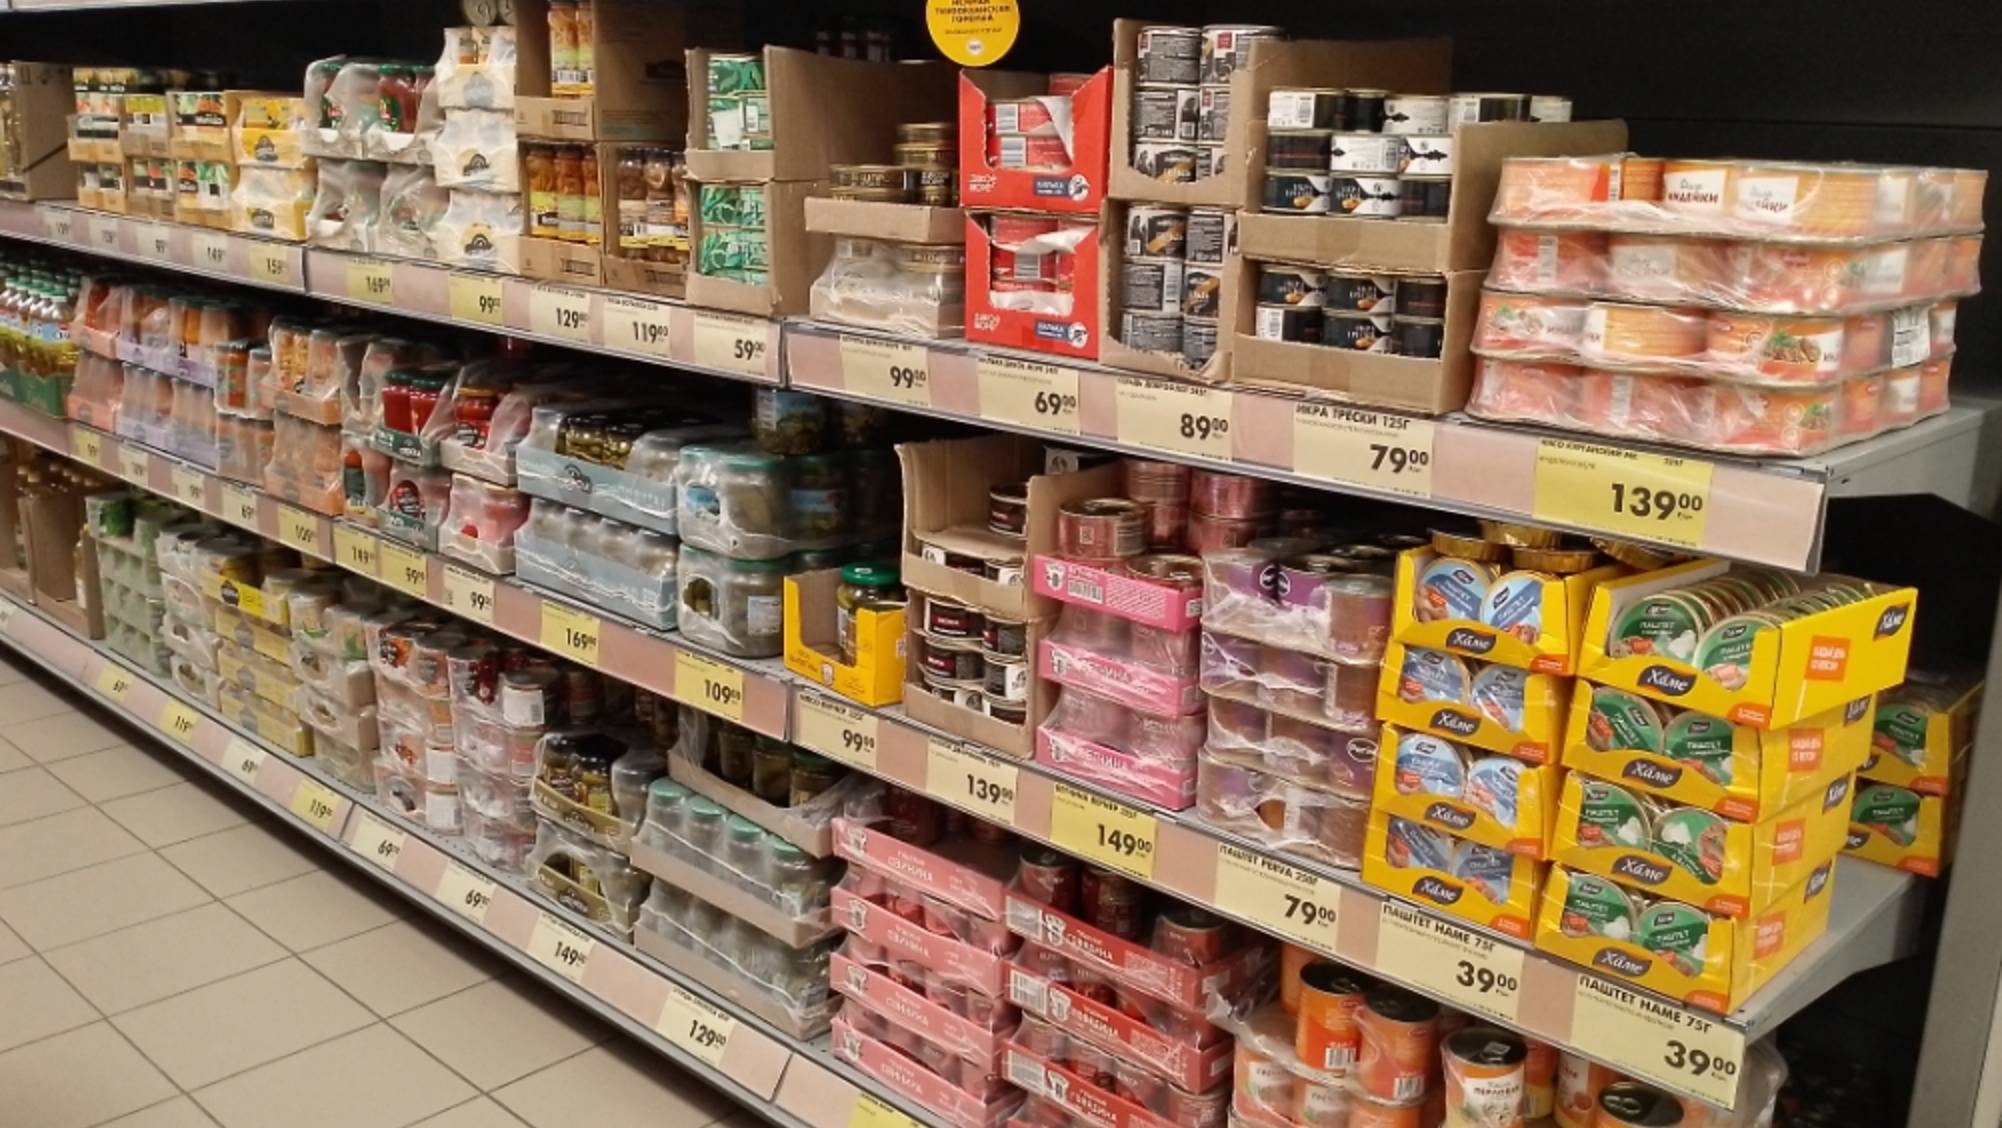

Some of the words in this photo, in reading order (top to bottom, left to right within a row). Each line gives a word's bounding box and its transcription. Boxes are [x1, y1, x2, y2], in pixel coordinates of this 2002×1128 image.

[1296, 405, 1328, 418] ИКРА
[1332, 410, 1378, 424] ТРЕСКИ
[1383, 416, 1411, 430] 125Г
[1382, 904, 1432, 931] ПАШТЕТ
[1434, 922, 1470, 944] НАМЕ
[1579, 976, 1637, 1006] ПАШТЕТ
[1639, 1000, 1682, 1023] НАМЕ
[1687, 1015, 1713, 1034] 75Г
